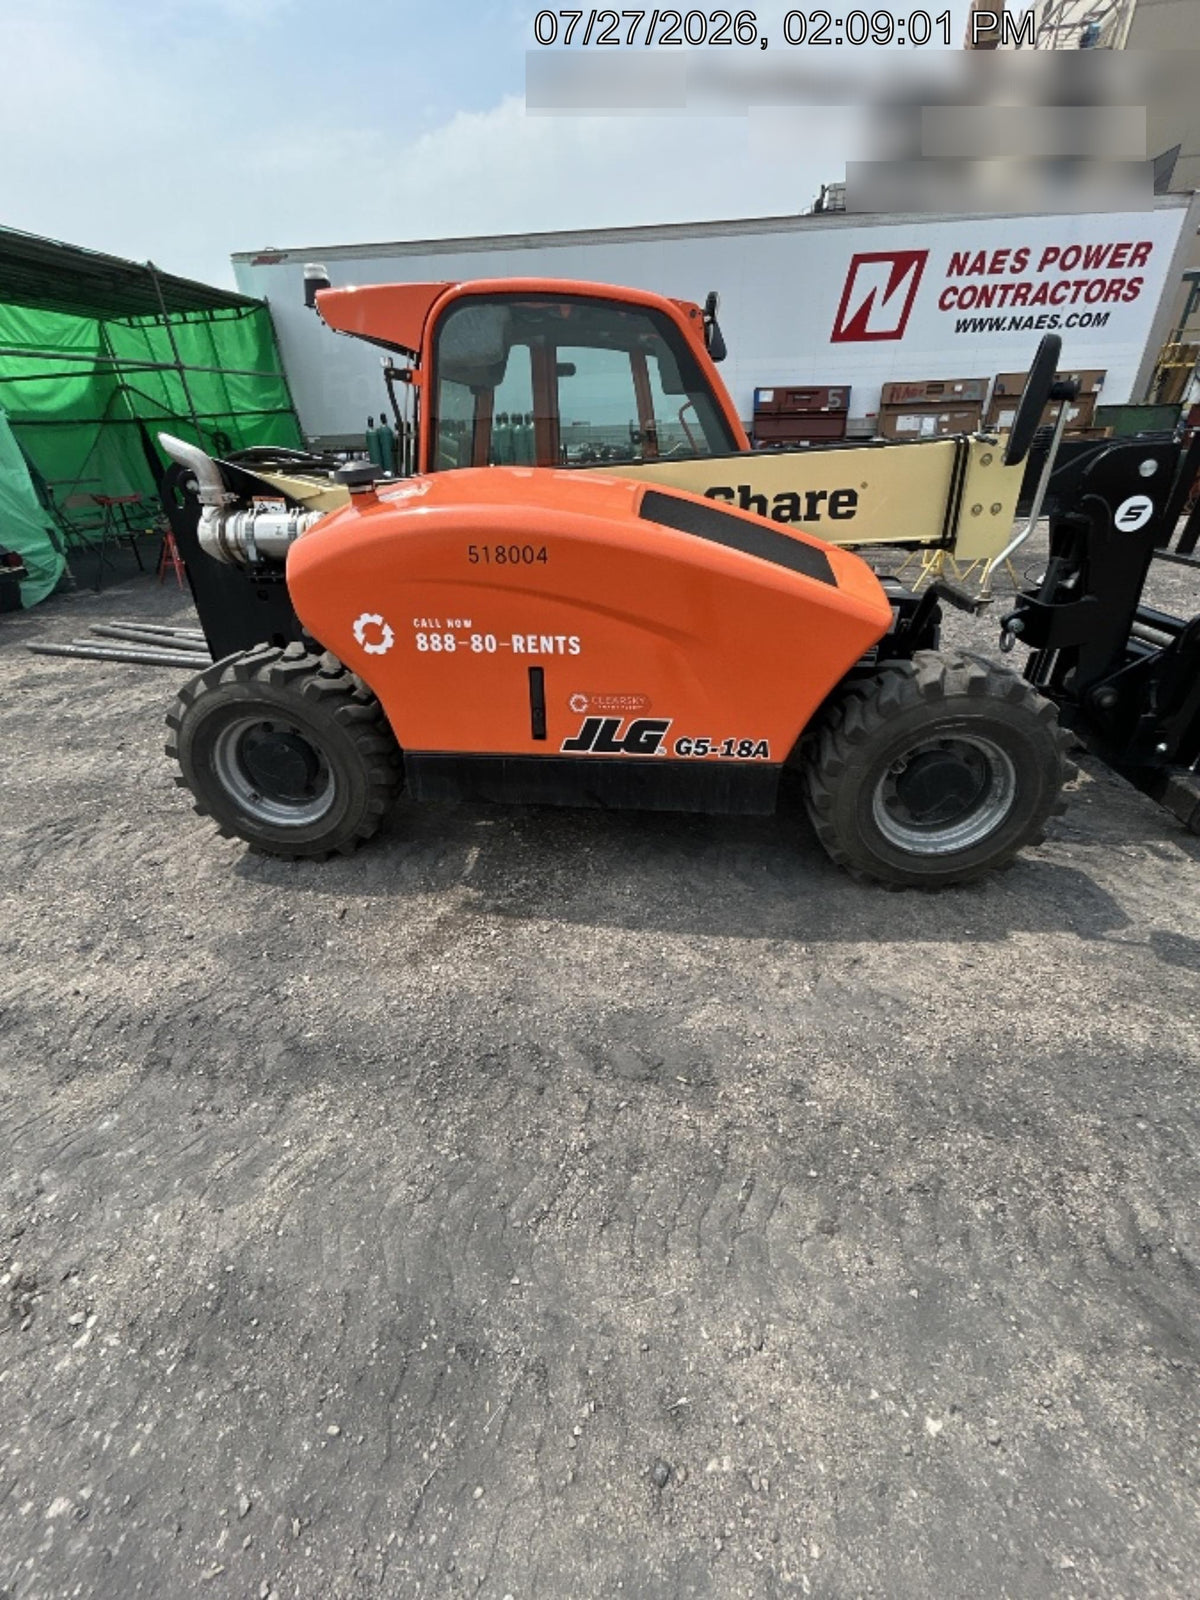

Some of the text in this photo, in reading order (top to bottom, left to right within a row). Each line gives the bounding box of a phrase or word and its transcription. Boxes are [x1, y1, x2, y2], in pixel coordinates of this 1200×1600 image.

[946, 241, 1154, 277] NAES POWER
[938, 277, 1145, 312] CONTRACTORS
[954, 311, 1111, 334] WWW.NAES.COM
[827, 388, 844, 409] 5
[468, 545, 549, 565] 518004
[413, 618, 472, 629] CALL NOW
[415, 632, 582, 656] 888-80-RENTS
[560, 716, 674, 755] JLG
[674, 736, 770, 760] G5-18A
